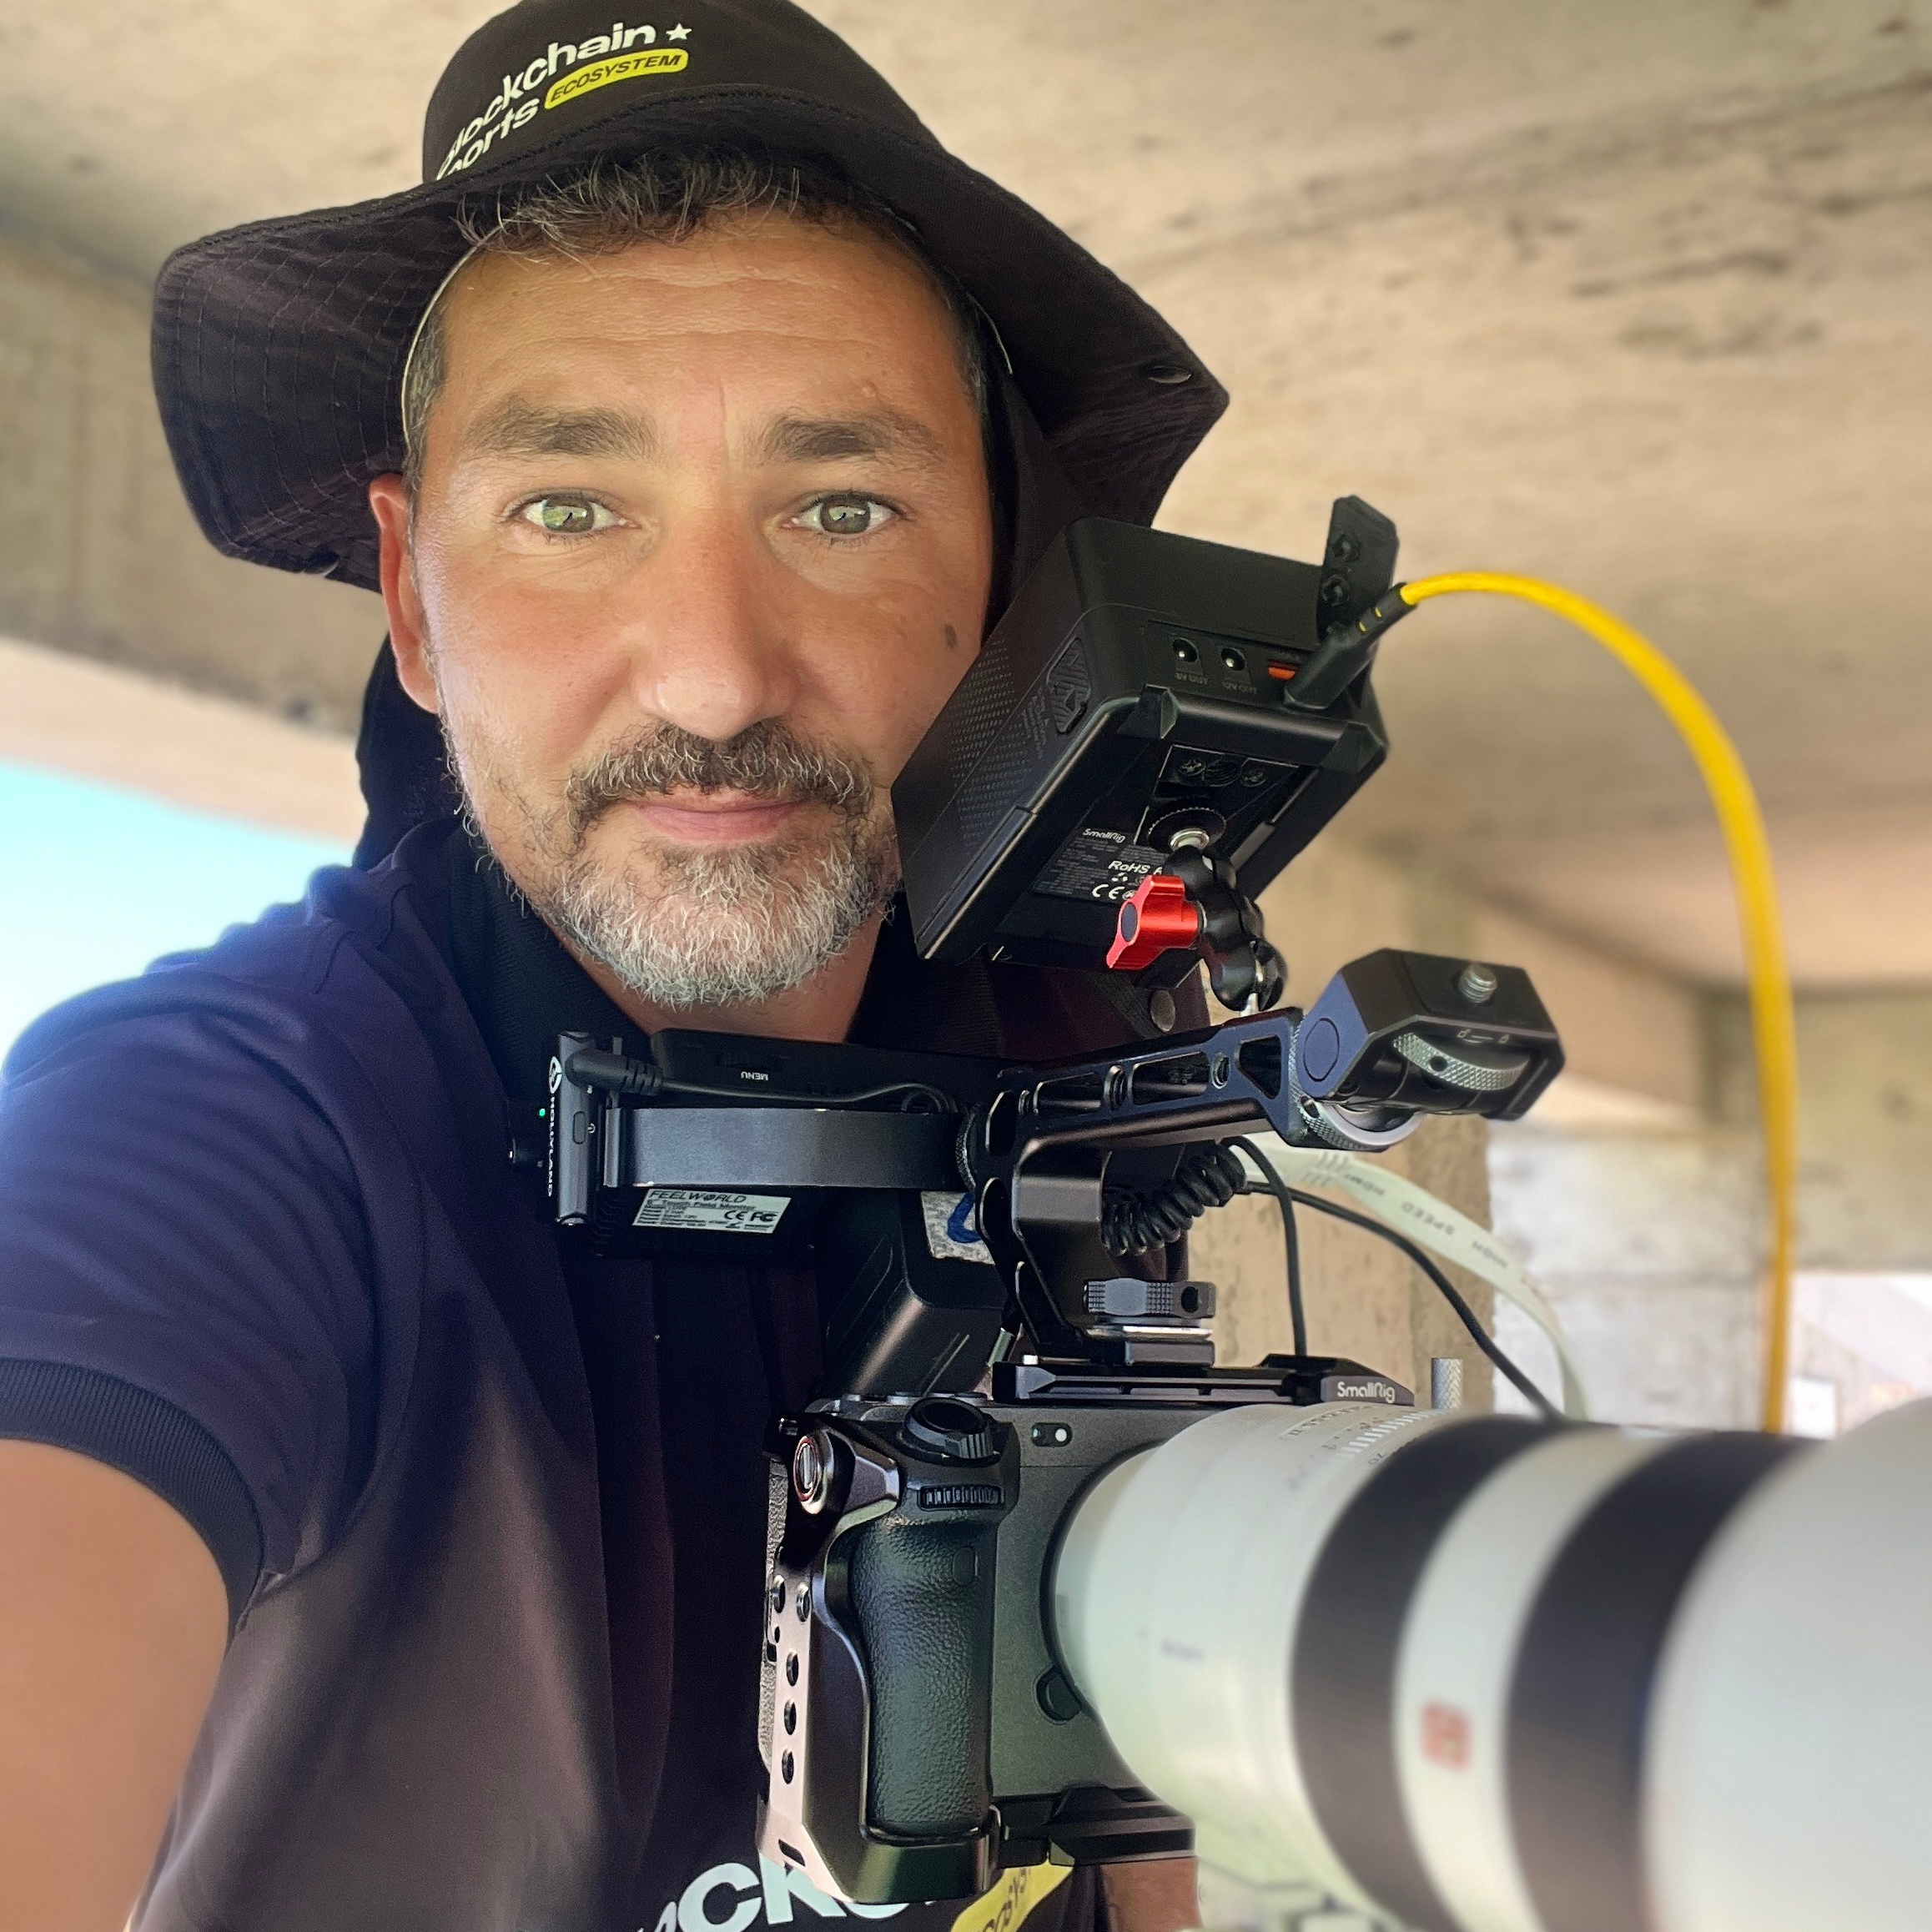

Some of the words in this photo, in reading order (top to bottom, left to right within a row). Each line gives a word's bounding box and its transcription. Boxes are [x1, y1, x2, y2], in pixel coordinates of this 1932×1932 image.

[551, 54, 682, 103] ECOSYSTEM
[445, 98, 540, 178] orts
[1083, 828, 1126, 844] SmallRig
[1109, 860, 1151, 874] RoHS
[740, 1071, 769, 1081] MENU
[1401, 1201, 1456, 1235] SPEED
[1337, 1381, 1396, 1404] SmallRig
